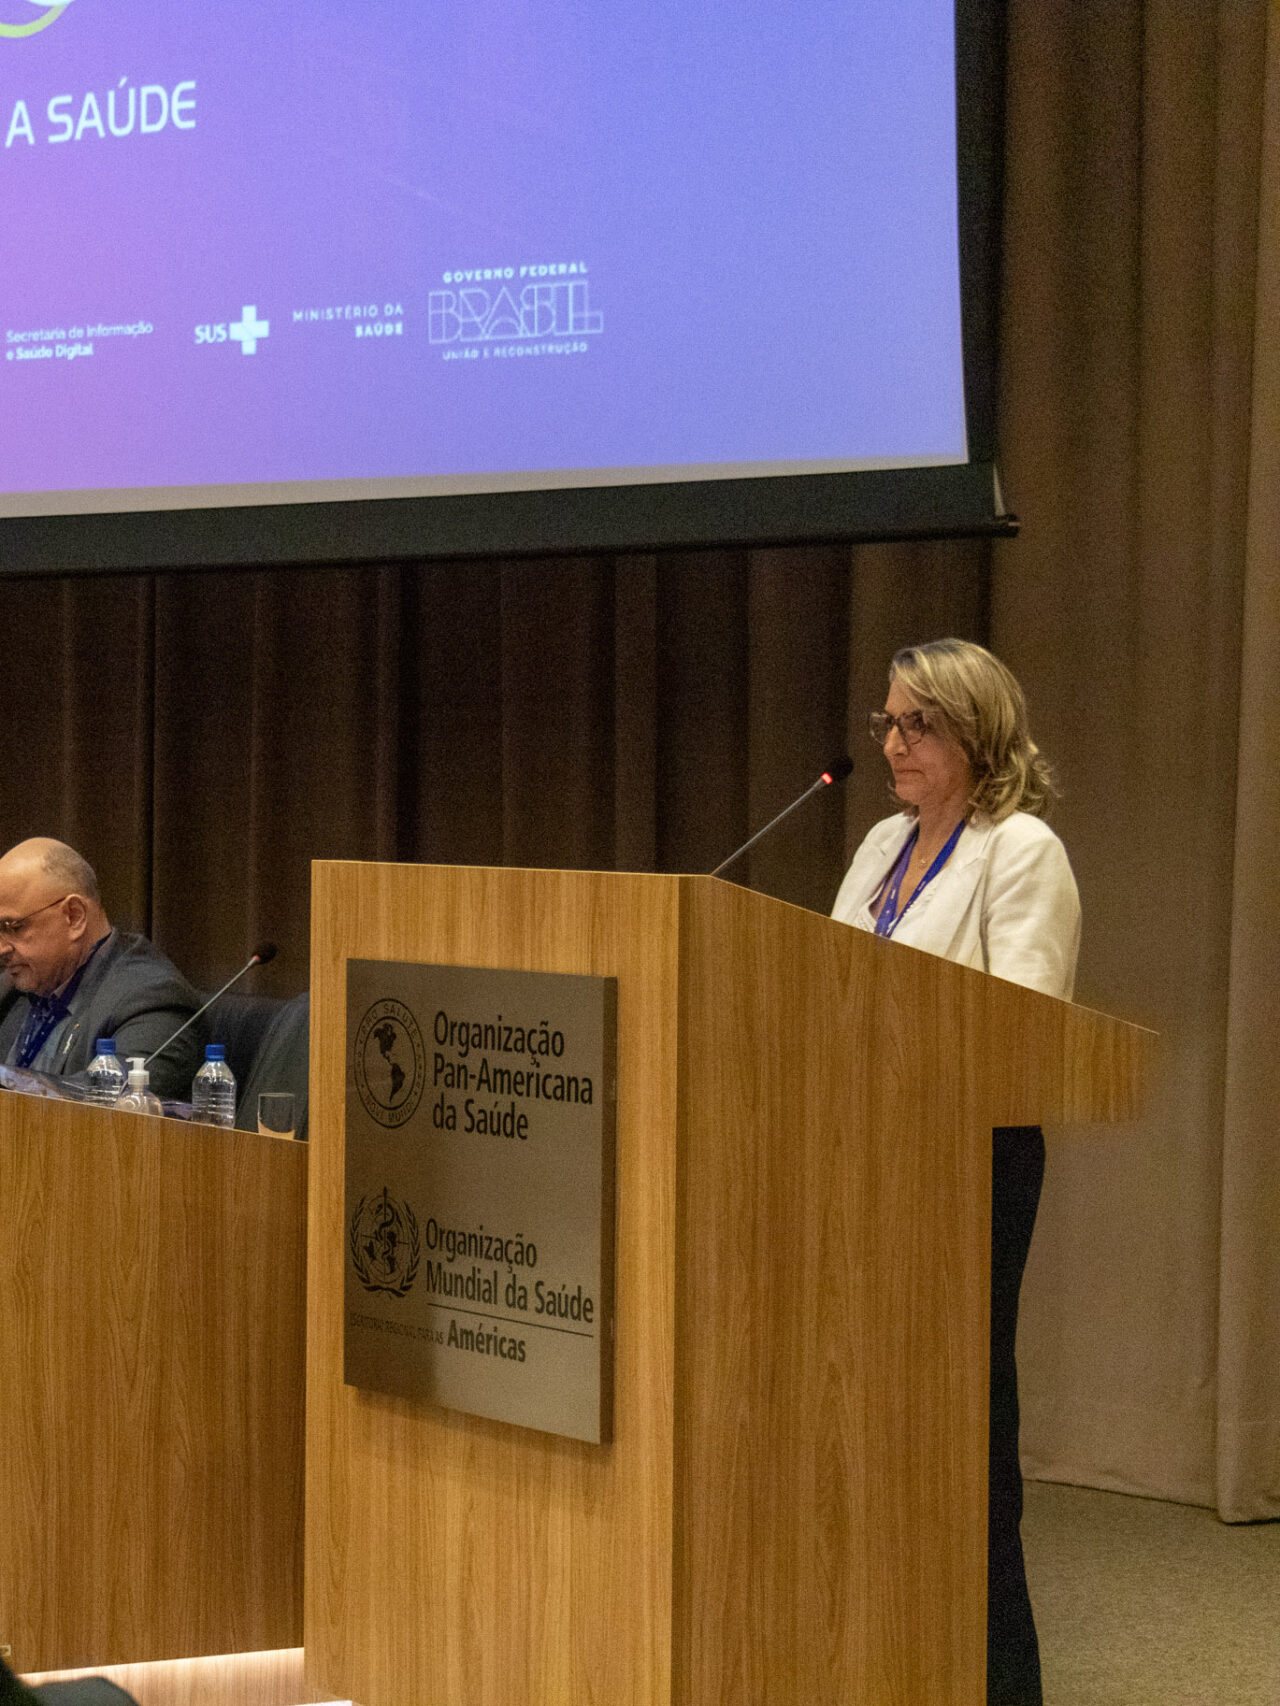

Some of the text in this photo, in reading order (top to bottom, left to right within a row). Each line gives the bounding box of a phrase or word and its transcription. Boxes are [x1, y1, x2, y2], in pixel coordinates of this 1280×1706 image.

[5, 100, 35, 148] A
[47, 76, 196, 143] SAÚDE
[443, 261, 588, 283] GOVERNO FEDERAL
[6, 320, 153, 343] Secretaria de Informação
[194, 324, 227, 344] SUS
[292, 303, 403, 321] MINISTÉRIO DA
[355, 322, 403, 338] SAÚDE
[428, 280, 604, 344] BRASIL
[6, 343, 94, 361] e Saúde Digital
[434, 1010, 565, 1066] Organização
[433, 1052, 593, 1105] Pan-Americana
[433, 1092, 528, 1141] da Saúde
[426, 1218, 537, 1274] Organização
[426, 1260, 594, 1323] Mundial da Saúde
[447, 1319, 526, 1363] Américas
